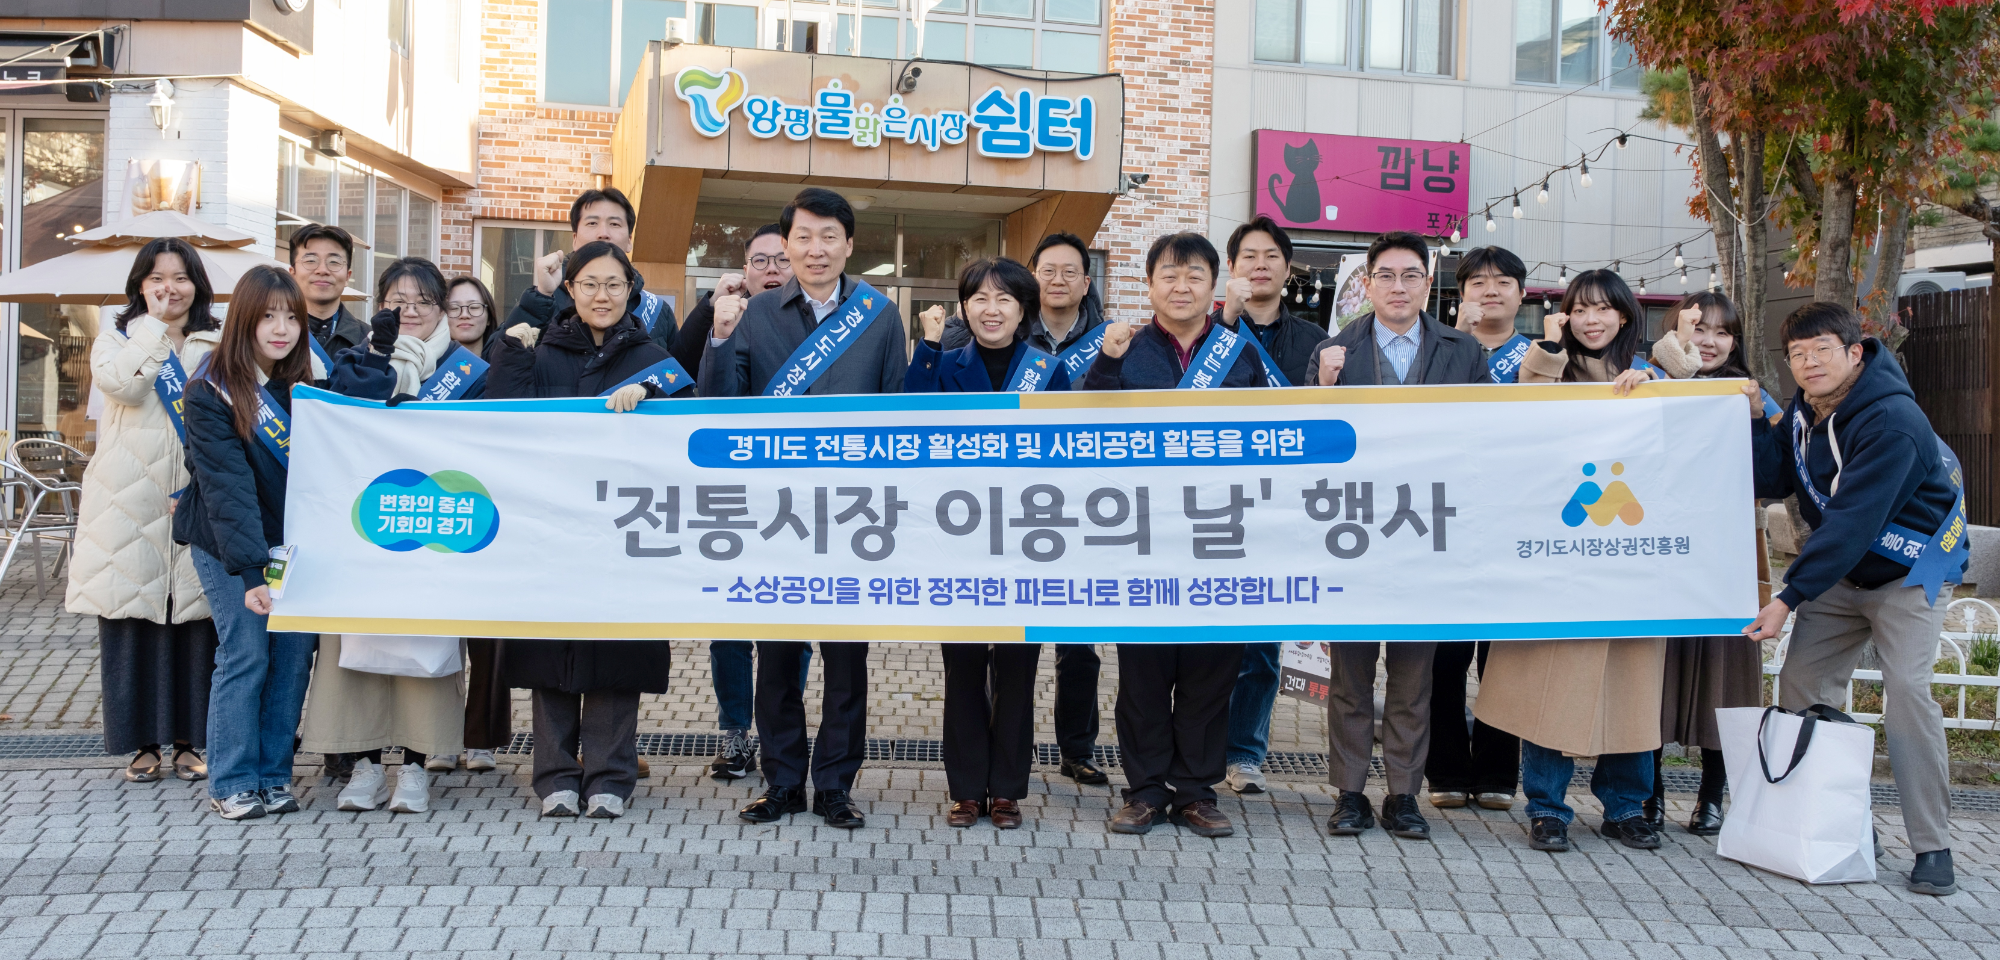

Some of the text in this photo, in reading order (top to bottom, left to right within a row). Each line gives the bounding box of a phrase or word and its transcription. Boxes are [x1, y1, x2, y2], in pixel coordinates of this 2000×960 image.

[973, 89, 1092, 157] 쉼터
[1377, 145, 1460, 194] 깜냥
[1427, 212, 1461, 230] 포차
[1203, 327, 1238, 373] 께하는
[1190, 369, 1213, 390] 봉
[727, 428, 1305, 461] 경기도 전통시장 활성화 및 사회공헌 활동을 위한
[379, 494, 475, 515] 변화의 중심
[377, 515, 473, 536] 기회의 경기
[935, 483, 1151, 563] 이용의
[1183, 477, 1272, 560] 날'
[1301, 477, 1457, 560] 행사
[1516, 535, 1690, 559] 경기도시장상권진흥원
[726, 576, 861, 605] 소상공인을
[867, 577, 921, 606] 위한
[928, 577, 1008, 606] 정직한
[1014, 578, 1121, 607] 파트너로
[1127, 577, 1180, 607] 함께
[1186, 575, 1320, 606] 성장합니다
[1285, 674, 1306, 691] 건대
